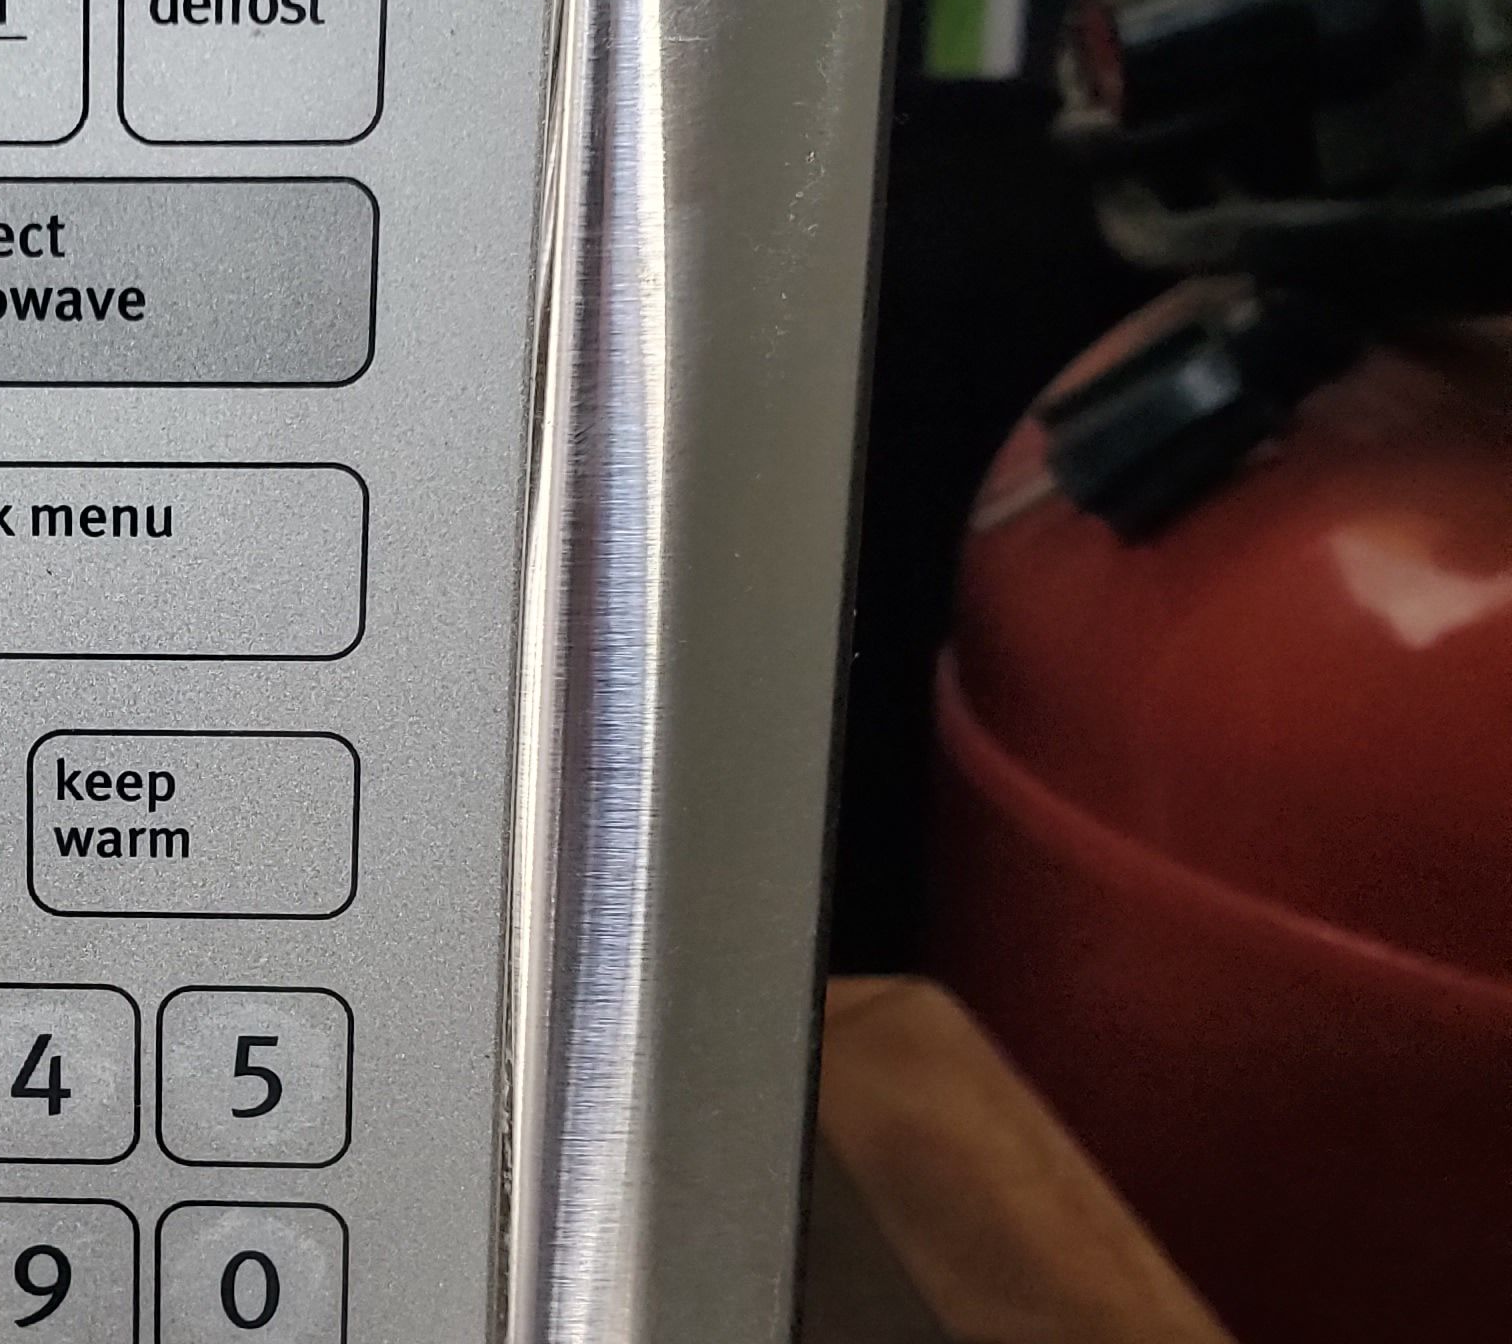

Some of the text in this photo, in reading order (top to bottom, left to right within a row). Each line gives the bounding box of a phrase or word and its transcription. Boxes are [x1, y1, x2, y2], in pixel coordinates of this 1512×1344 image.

[32, 505, 172, 537] menu
[57, 758, 175, 812] keep
[54, 827, 189, 858] warm
[11, 1034, 71, 1116] 4
[232, 1036, 282, 1118] 5
[14, 1245, 71, 1328] 9
[221, 1250, 280, 1329] 0
